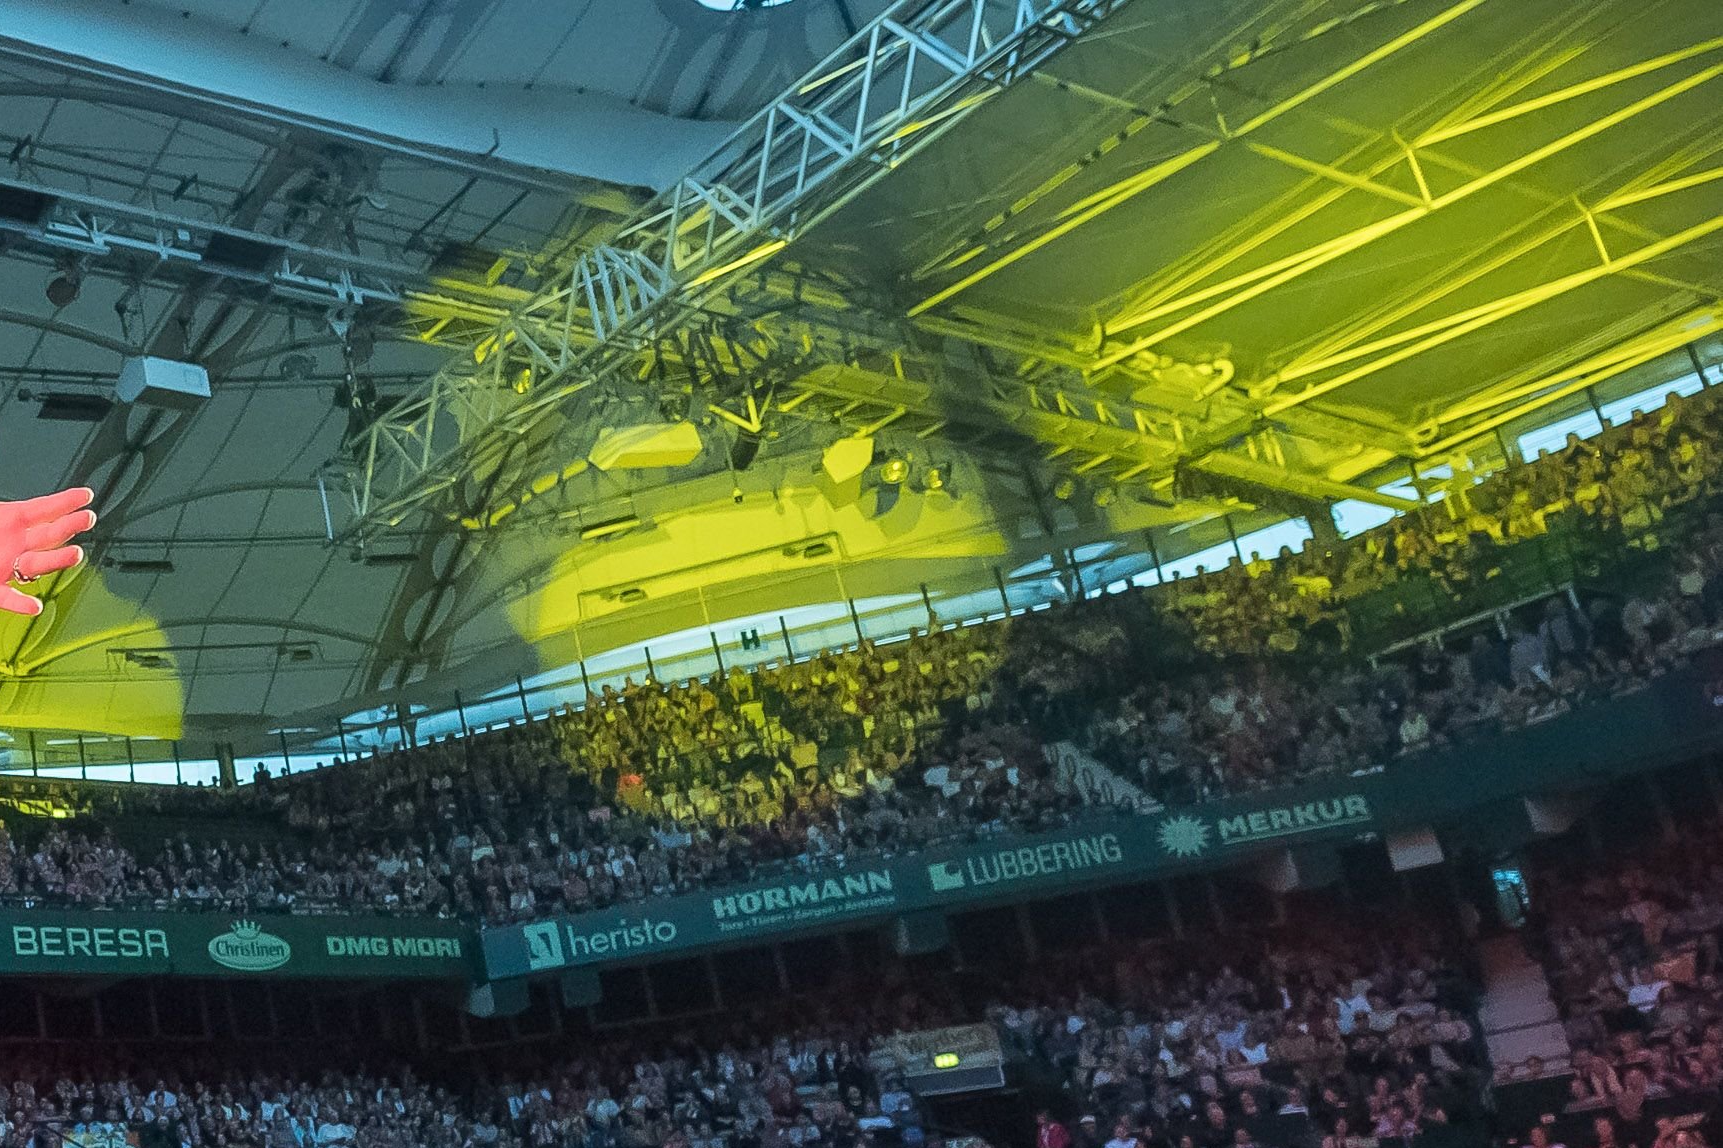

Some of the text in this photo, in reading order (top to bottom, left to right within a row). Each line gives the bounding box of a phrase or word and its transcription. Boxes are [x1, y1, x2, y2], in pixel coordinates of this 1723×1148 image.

[1219, 794, 1368, 838] MERKUR
[12, 926, 169, 958] BERESA
[216, 940, 285, 957] Christinen
[325, 935, 462, 958] DMG MORI
[569, 919, 676, 956] heristo
